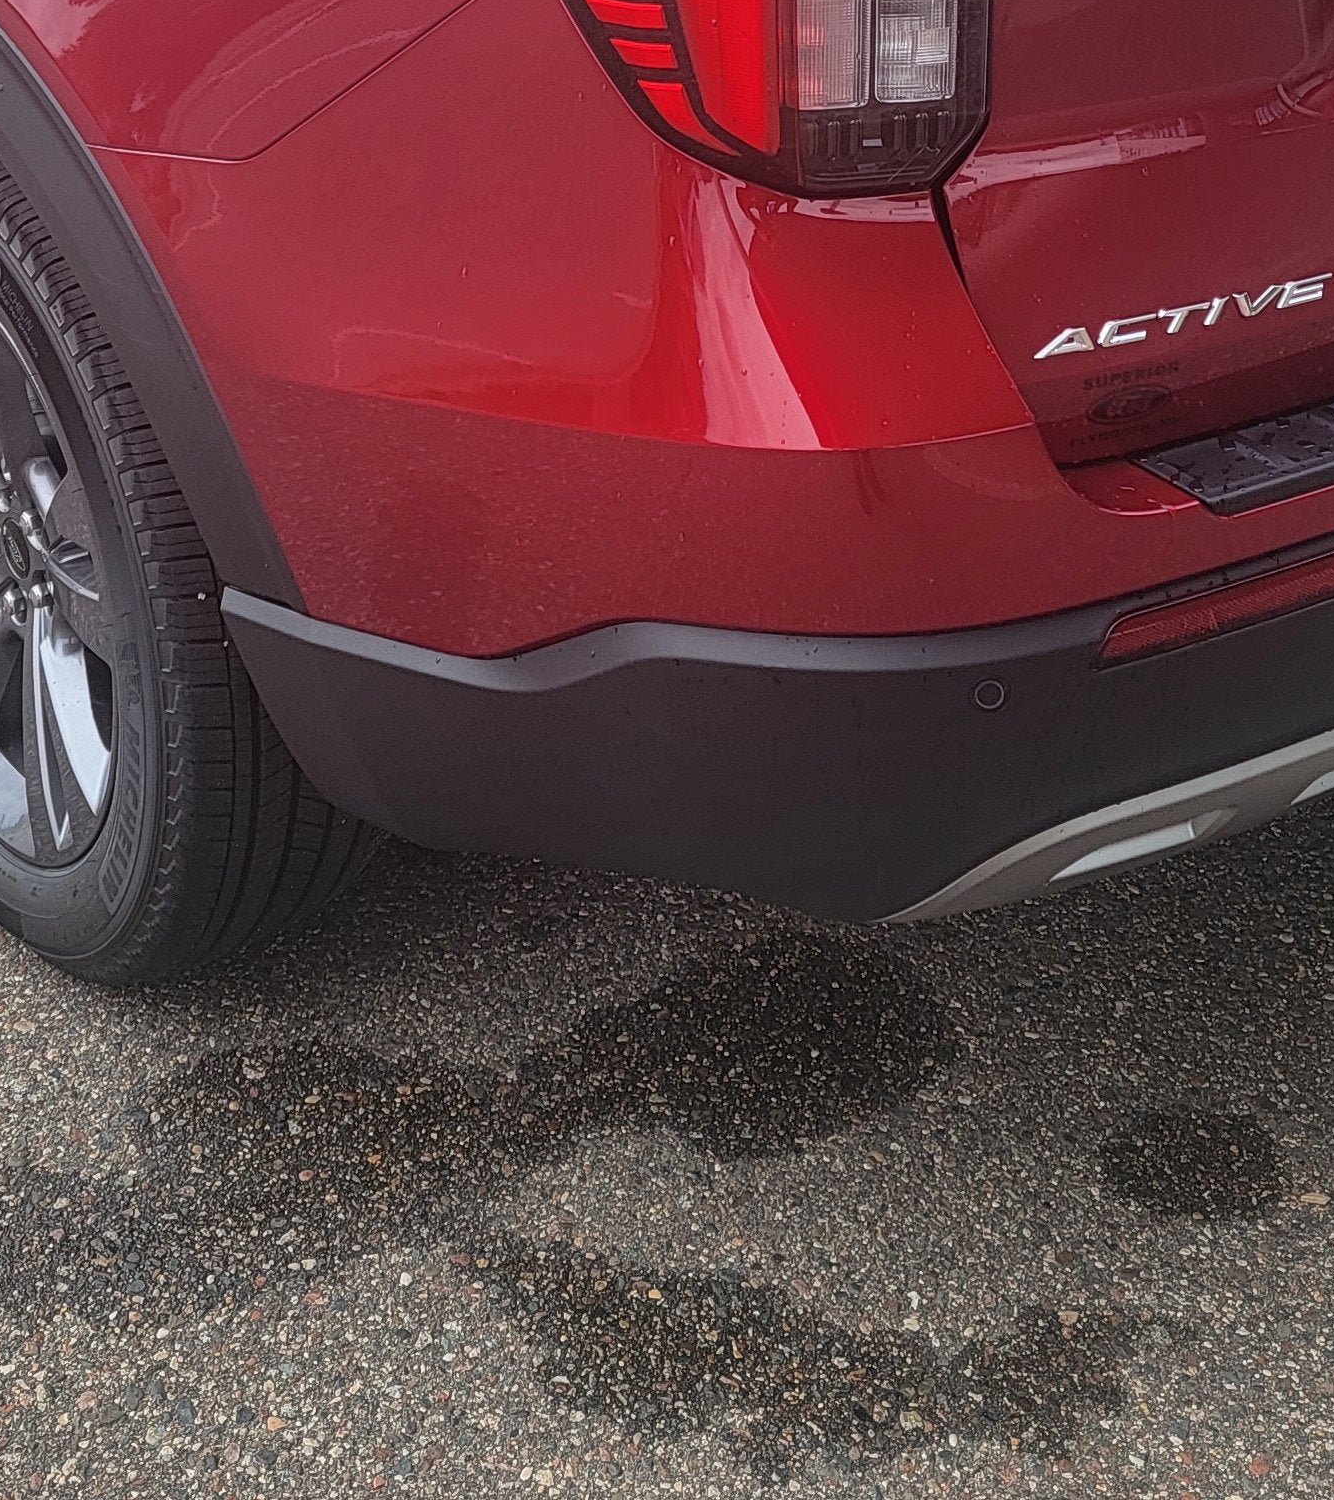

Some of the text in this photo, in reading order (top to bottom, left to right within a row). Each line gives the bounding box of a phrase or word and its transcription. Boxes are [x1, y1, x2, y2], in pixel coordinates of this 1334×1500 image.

[0, 281, 34, 332] MICHELIN
[1034, 272, 1333, 359] ACTIVE
[1083, 361, 1180, 390] SUPERIOR
[103, 720, 141, 902] MICHELIN
